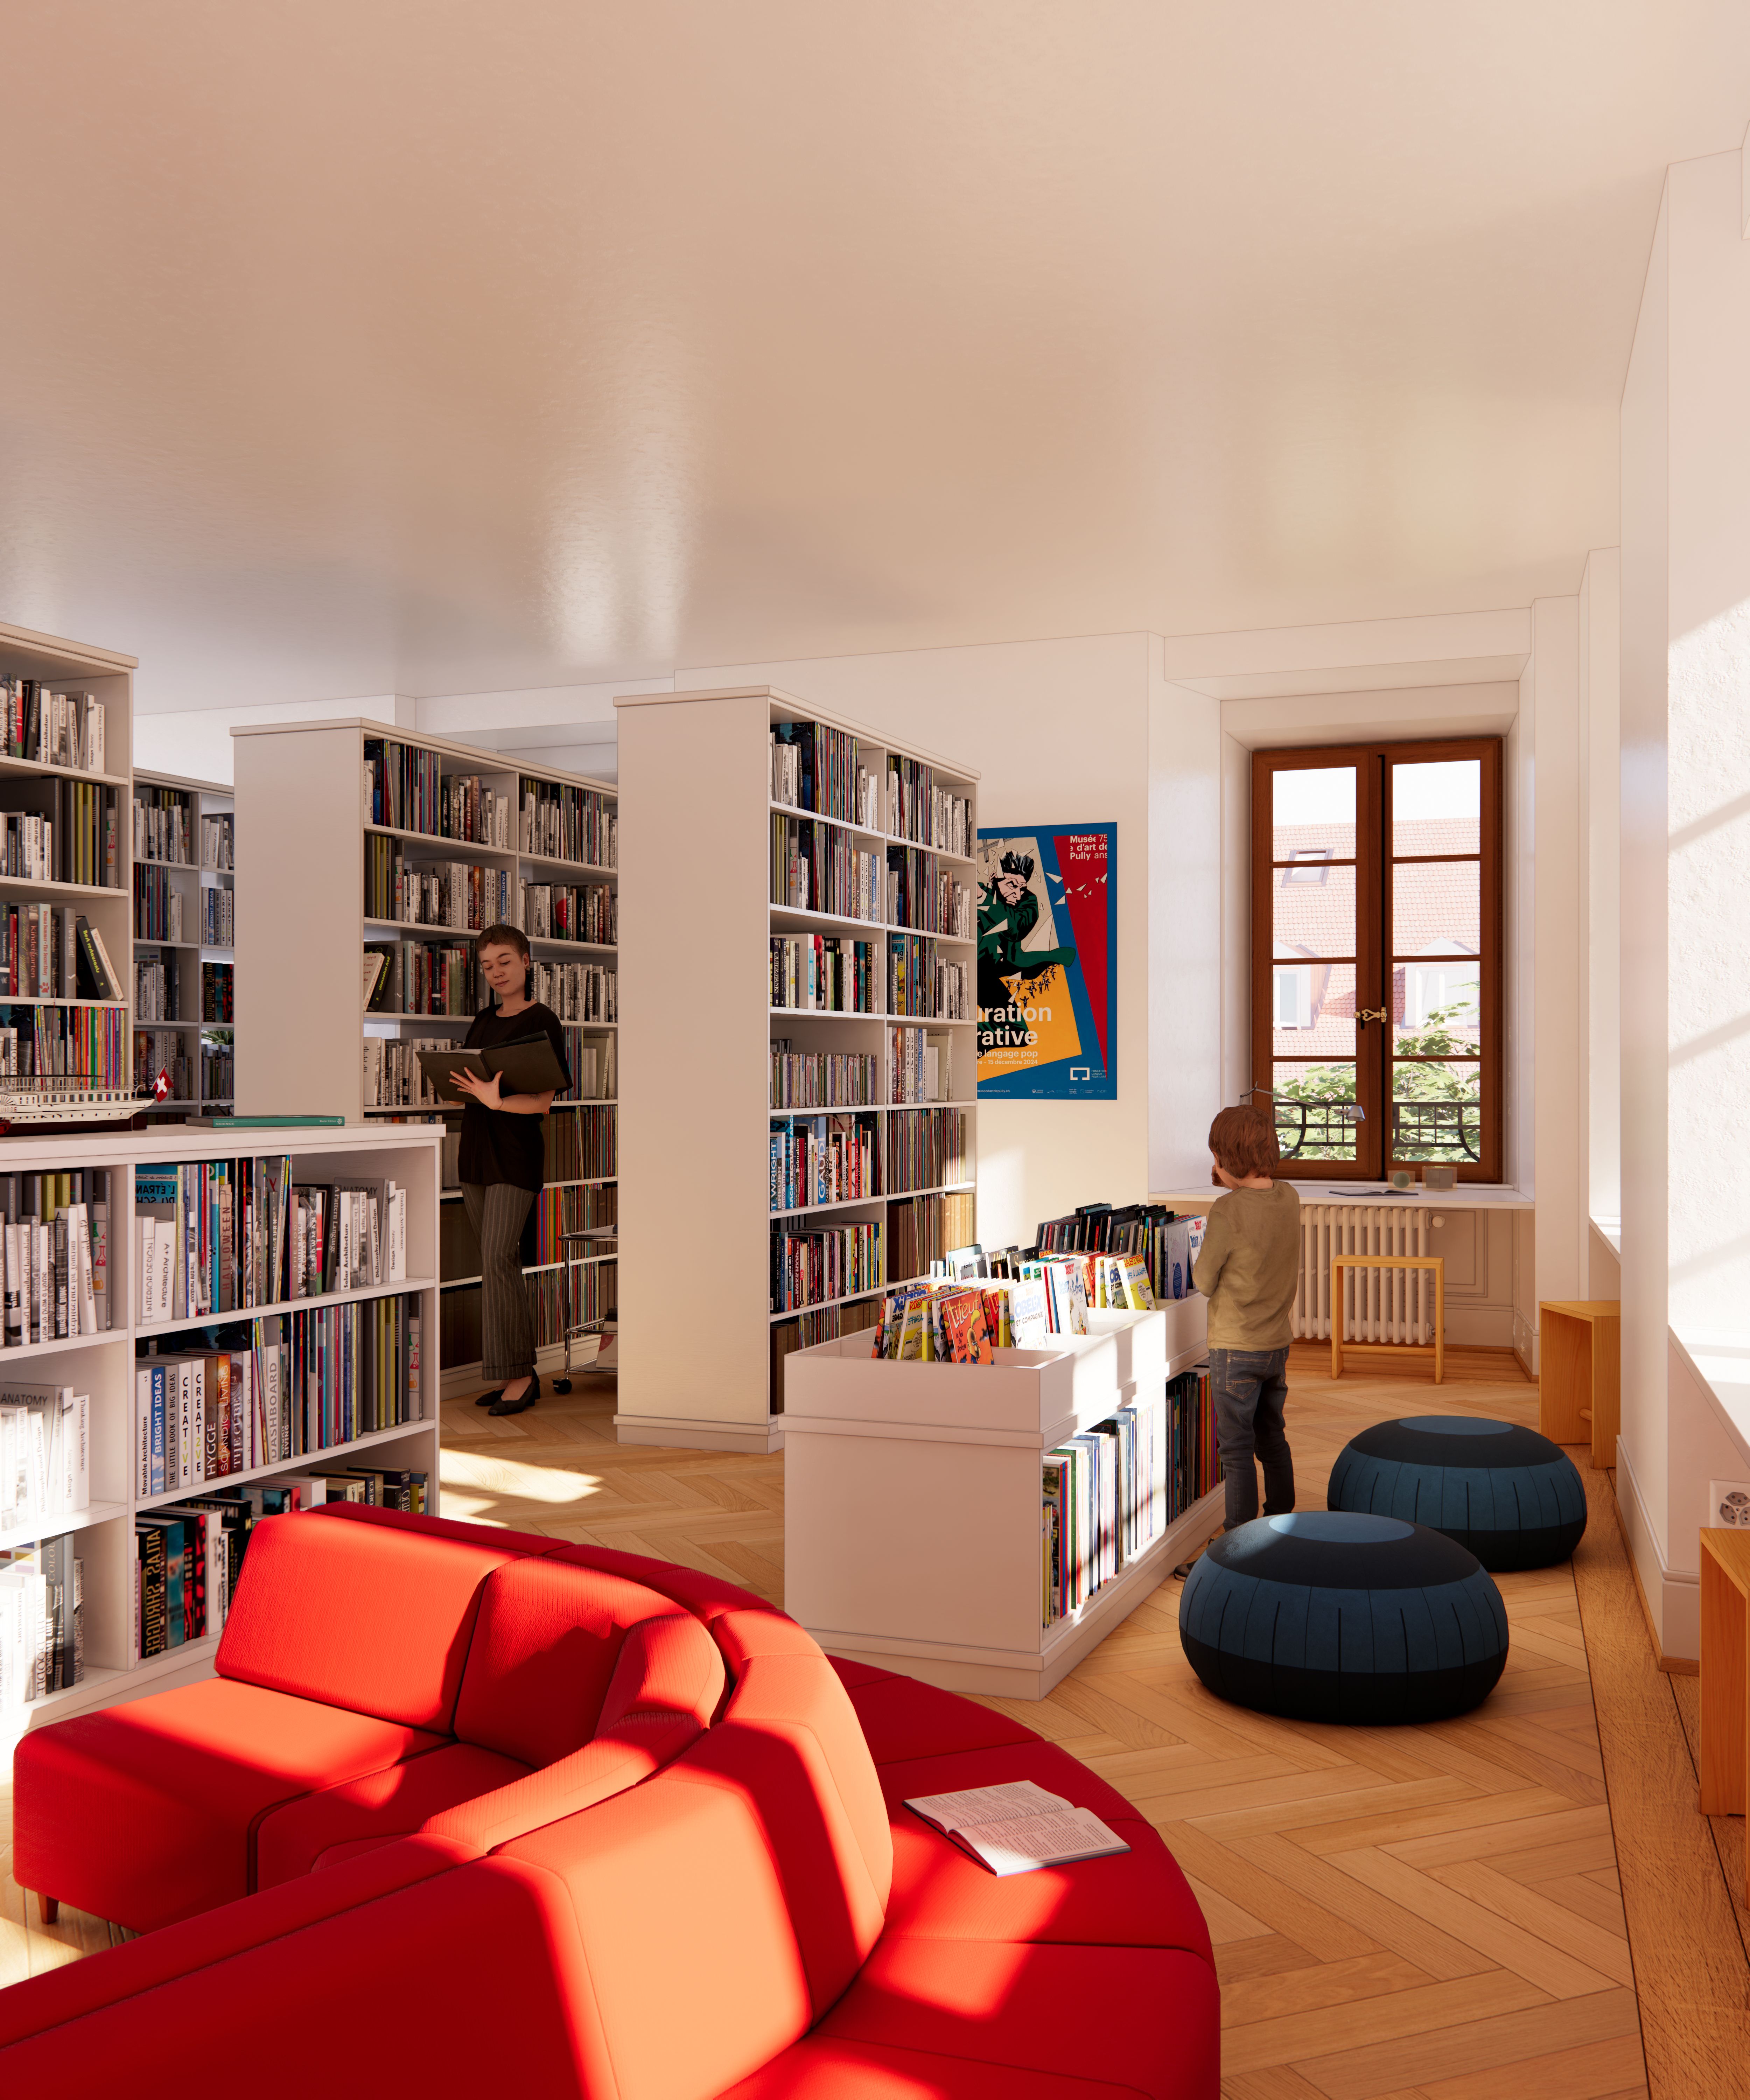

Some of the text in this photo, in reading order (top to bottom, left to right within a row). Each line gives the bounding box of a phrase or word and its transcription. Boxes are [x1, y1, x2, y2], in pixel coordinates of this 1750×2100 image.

[1070, 852, 1091, 861] Pully
[83, 930, 100, 973] Best restaurants
[985, 1050, 1019, 1059] langage
[222, 1207, 230, 1290] HALLOWEEN
[330, 1221, 339, 1254] Language
[163, 1243, 170, 1255] A+
[1, 1394, 48, 1406] ANATOMY
[169, 1412, 175, 1420] OF
[220, 1365, 229, 1472] SCANDIC LIVING
[207, 1422, 216, 1475] HYGGE
